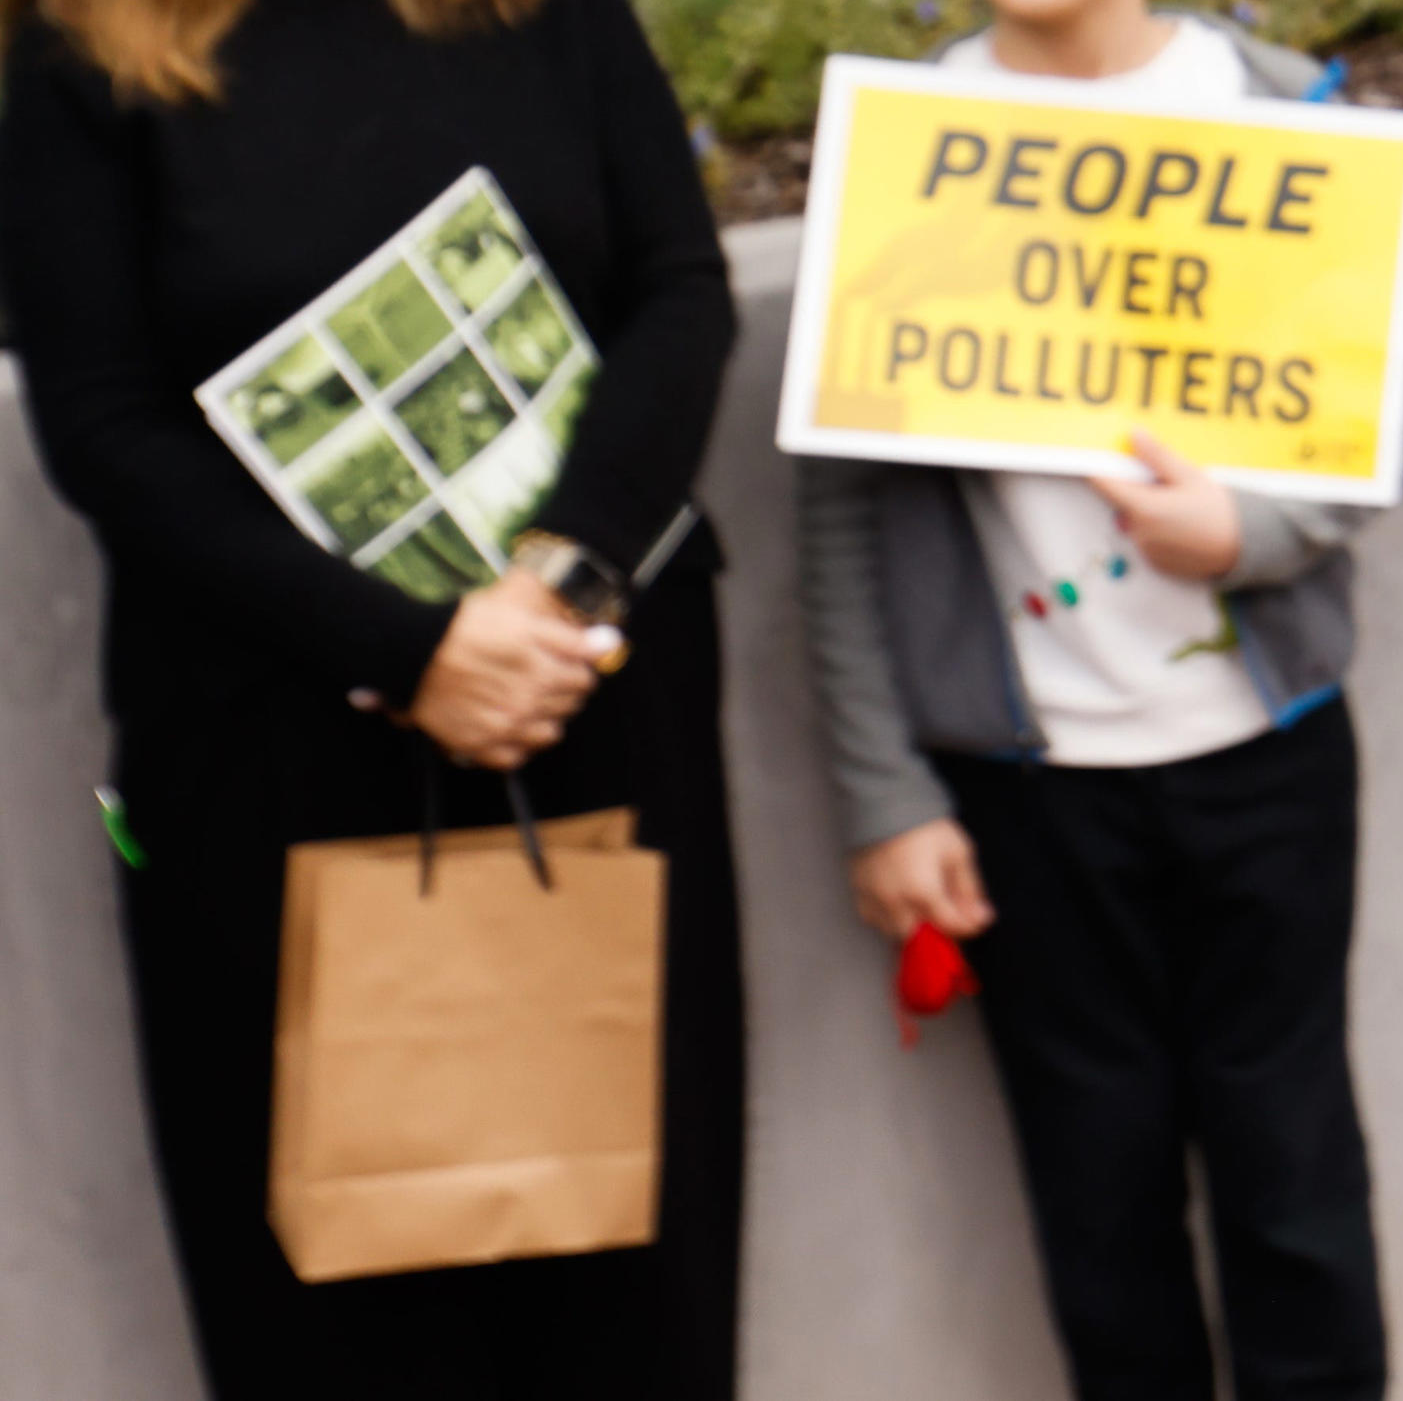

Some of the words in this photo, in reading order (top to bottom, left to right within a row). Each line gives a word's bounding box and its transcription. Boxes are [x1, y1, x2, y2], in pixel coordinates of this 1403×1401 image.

[921, 131, 1329, 234] PEOPLE
[1015, 239, 1210, 319] OVER
[887, 322, 1316, 424] POLLUTERS
